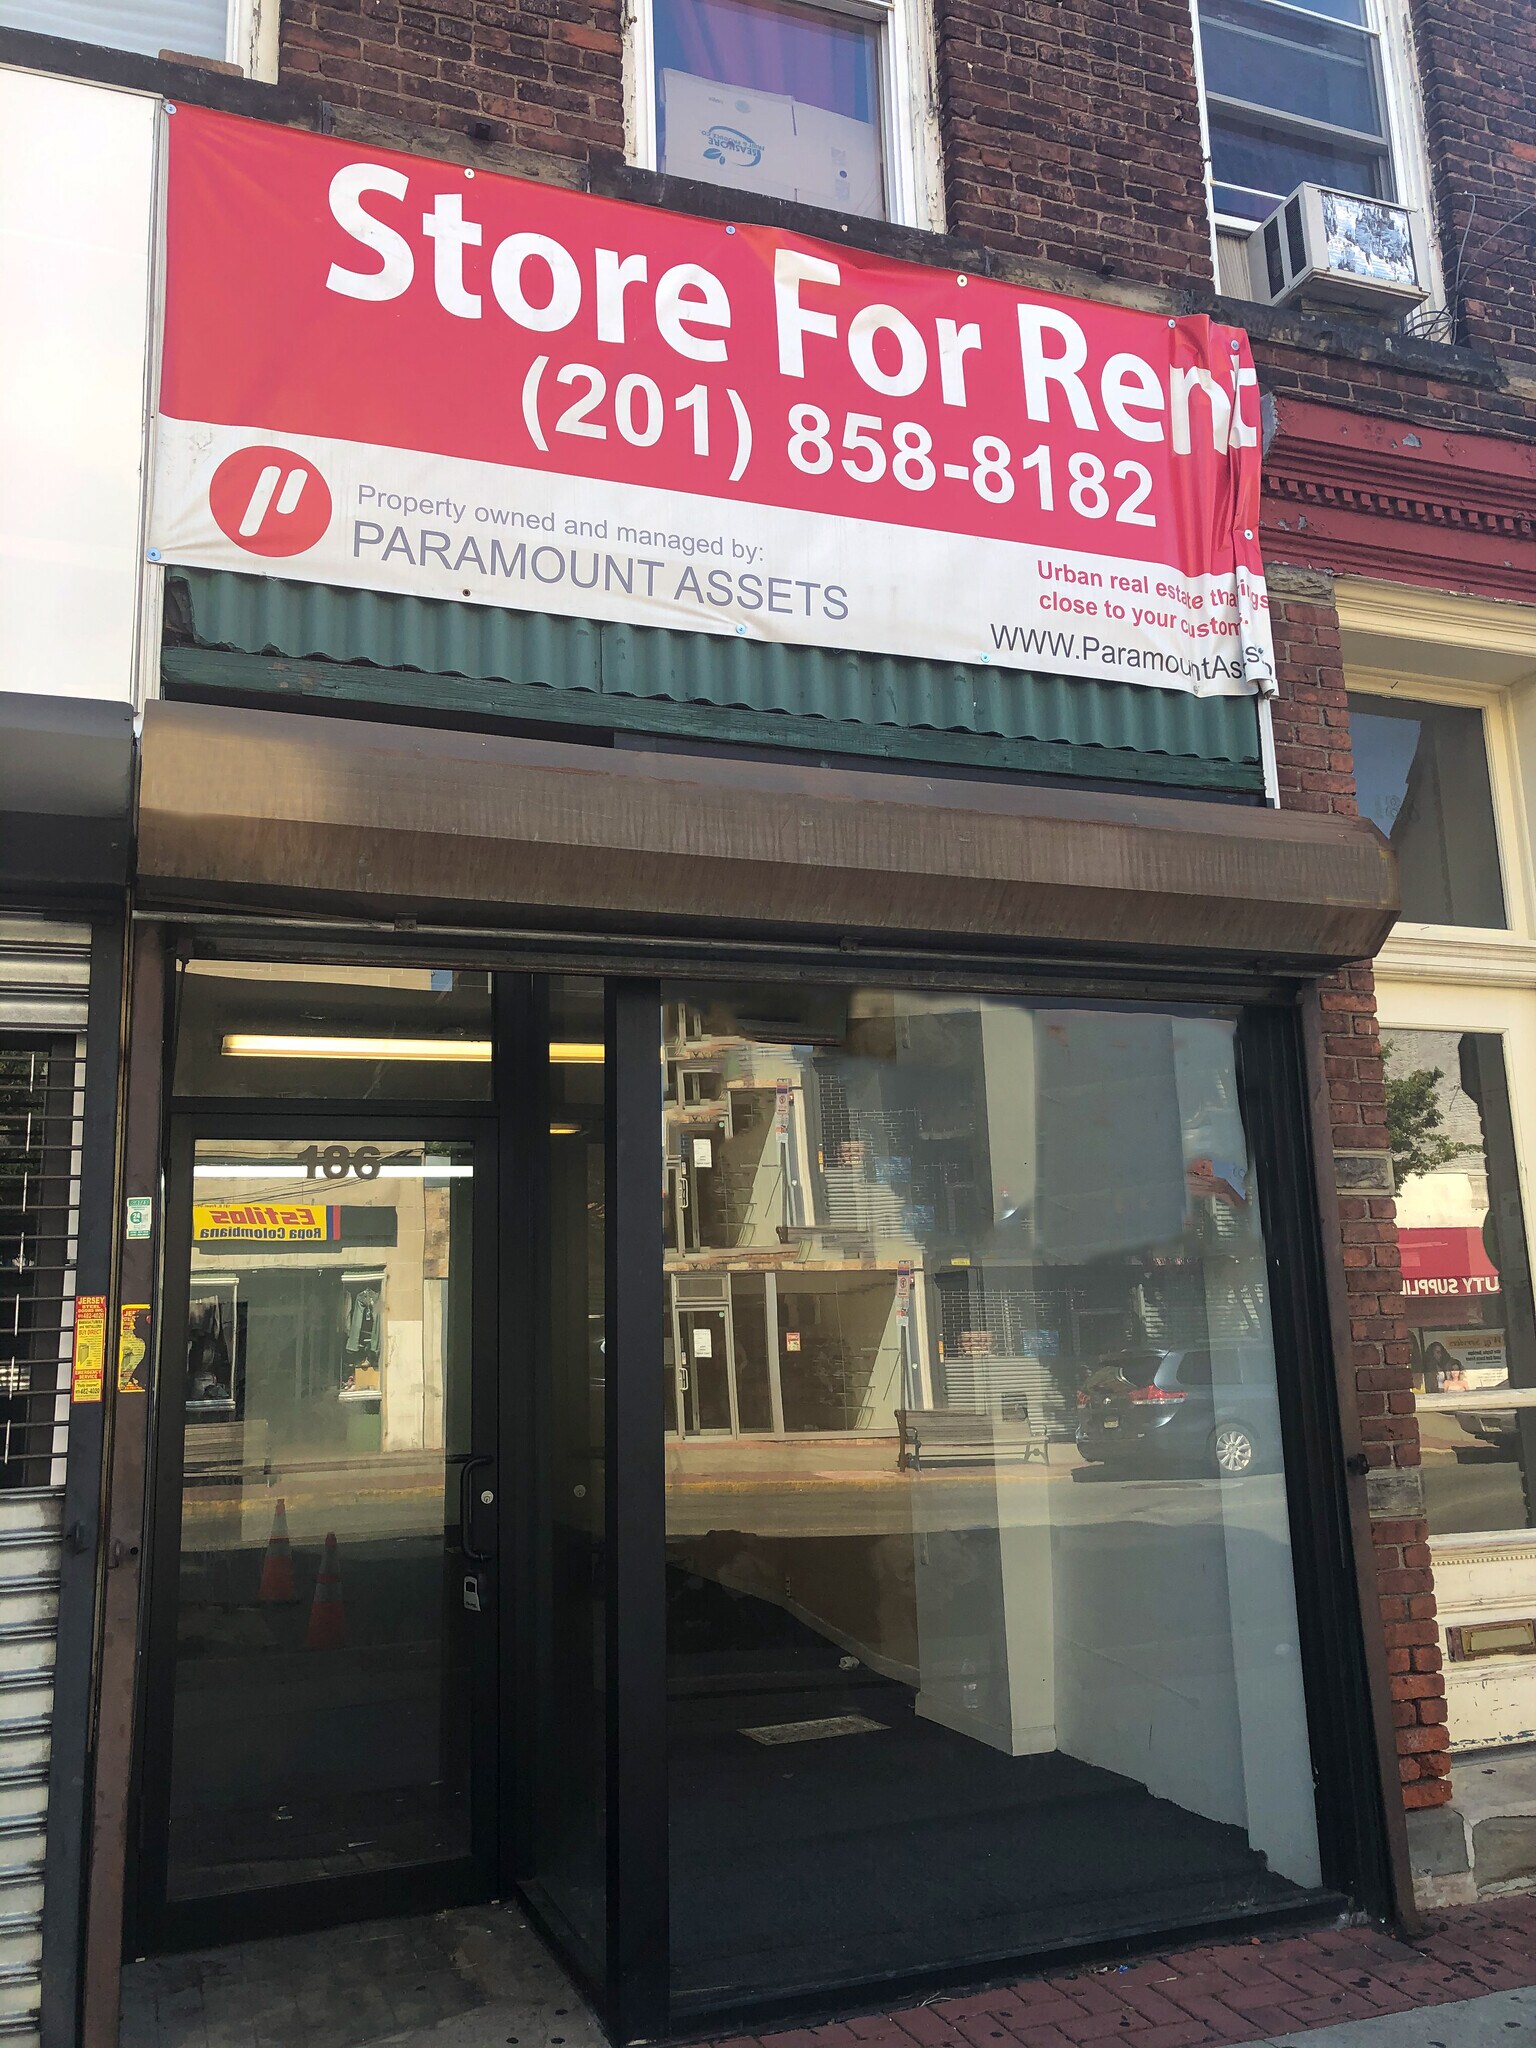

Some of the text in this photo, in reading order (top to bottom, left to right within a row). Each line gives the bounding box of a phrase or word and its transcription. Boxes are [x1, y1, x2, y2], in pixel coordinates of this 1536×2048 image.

[708, 137, 758, 156] SEASHORE
[326, 163, 1257, 455] Store For Rent
[522, 355, 1156, 527] (201) 858-8182
[358, 484, 763, 564] Property owned and managed by:
[353, 520, 848, 620] PARAMOUNT ASSETS
[1037, 560, 1102, 587] Urban
[1110, 574, 1149, 594] real
[1156, 582, 1204, 609] estate
[1039, 591, 1097, 616] close
[1104, 597, 1126, 619] to
[1132, 607, 1177, 629] your
[298, 1145, 381, 1179] 186
[78, 1297, 105, 1305] JERSEY
